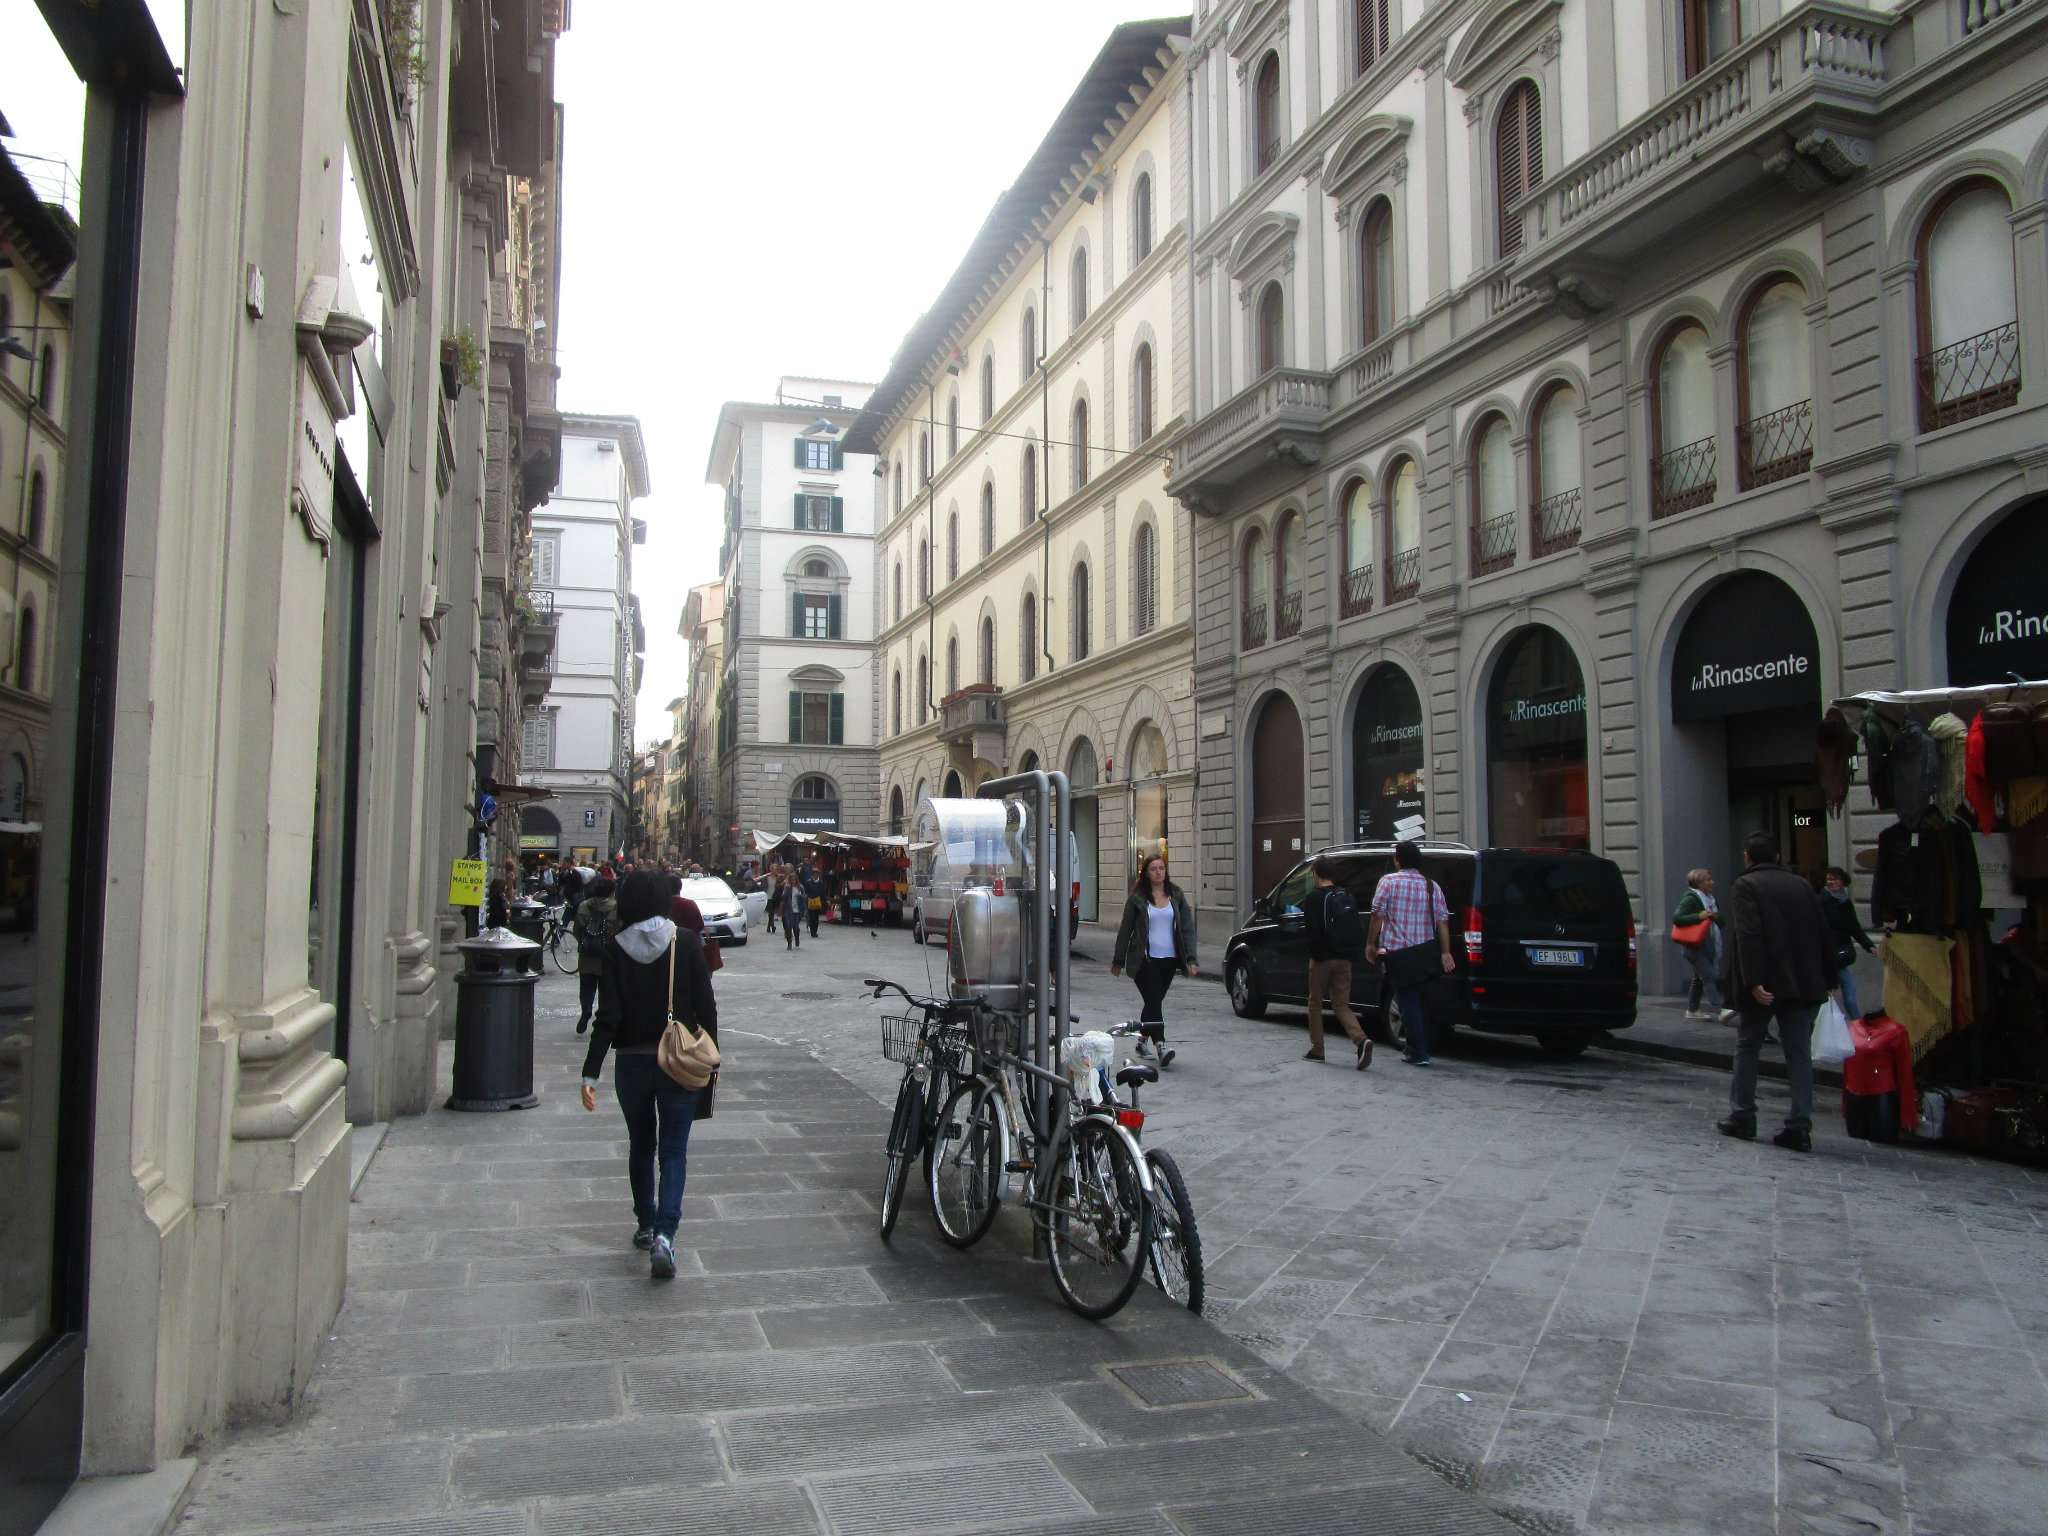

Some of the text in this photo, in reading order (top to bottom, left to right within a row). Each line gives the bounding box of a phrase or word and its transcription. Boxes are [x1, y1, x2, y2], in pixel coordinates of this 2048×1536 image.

[793, 817, 836, 825] CALZEDONIA
[1794, 813, 1811, 826] ior
[457, 862, 481, 870] STAMPS
